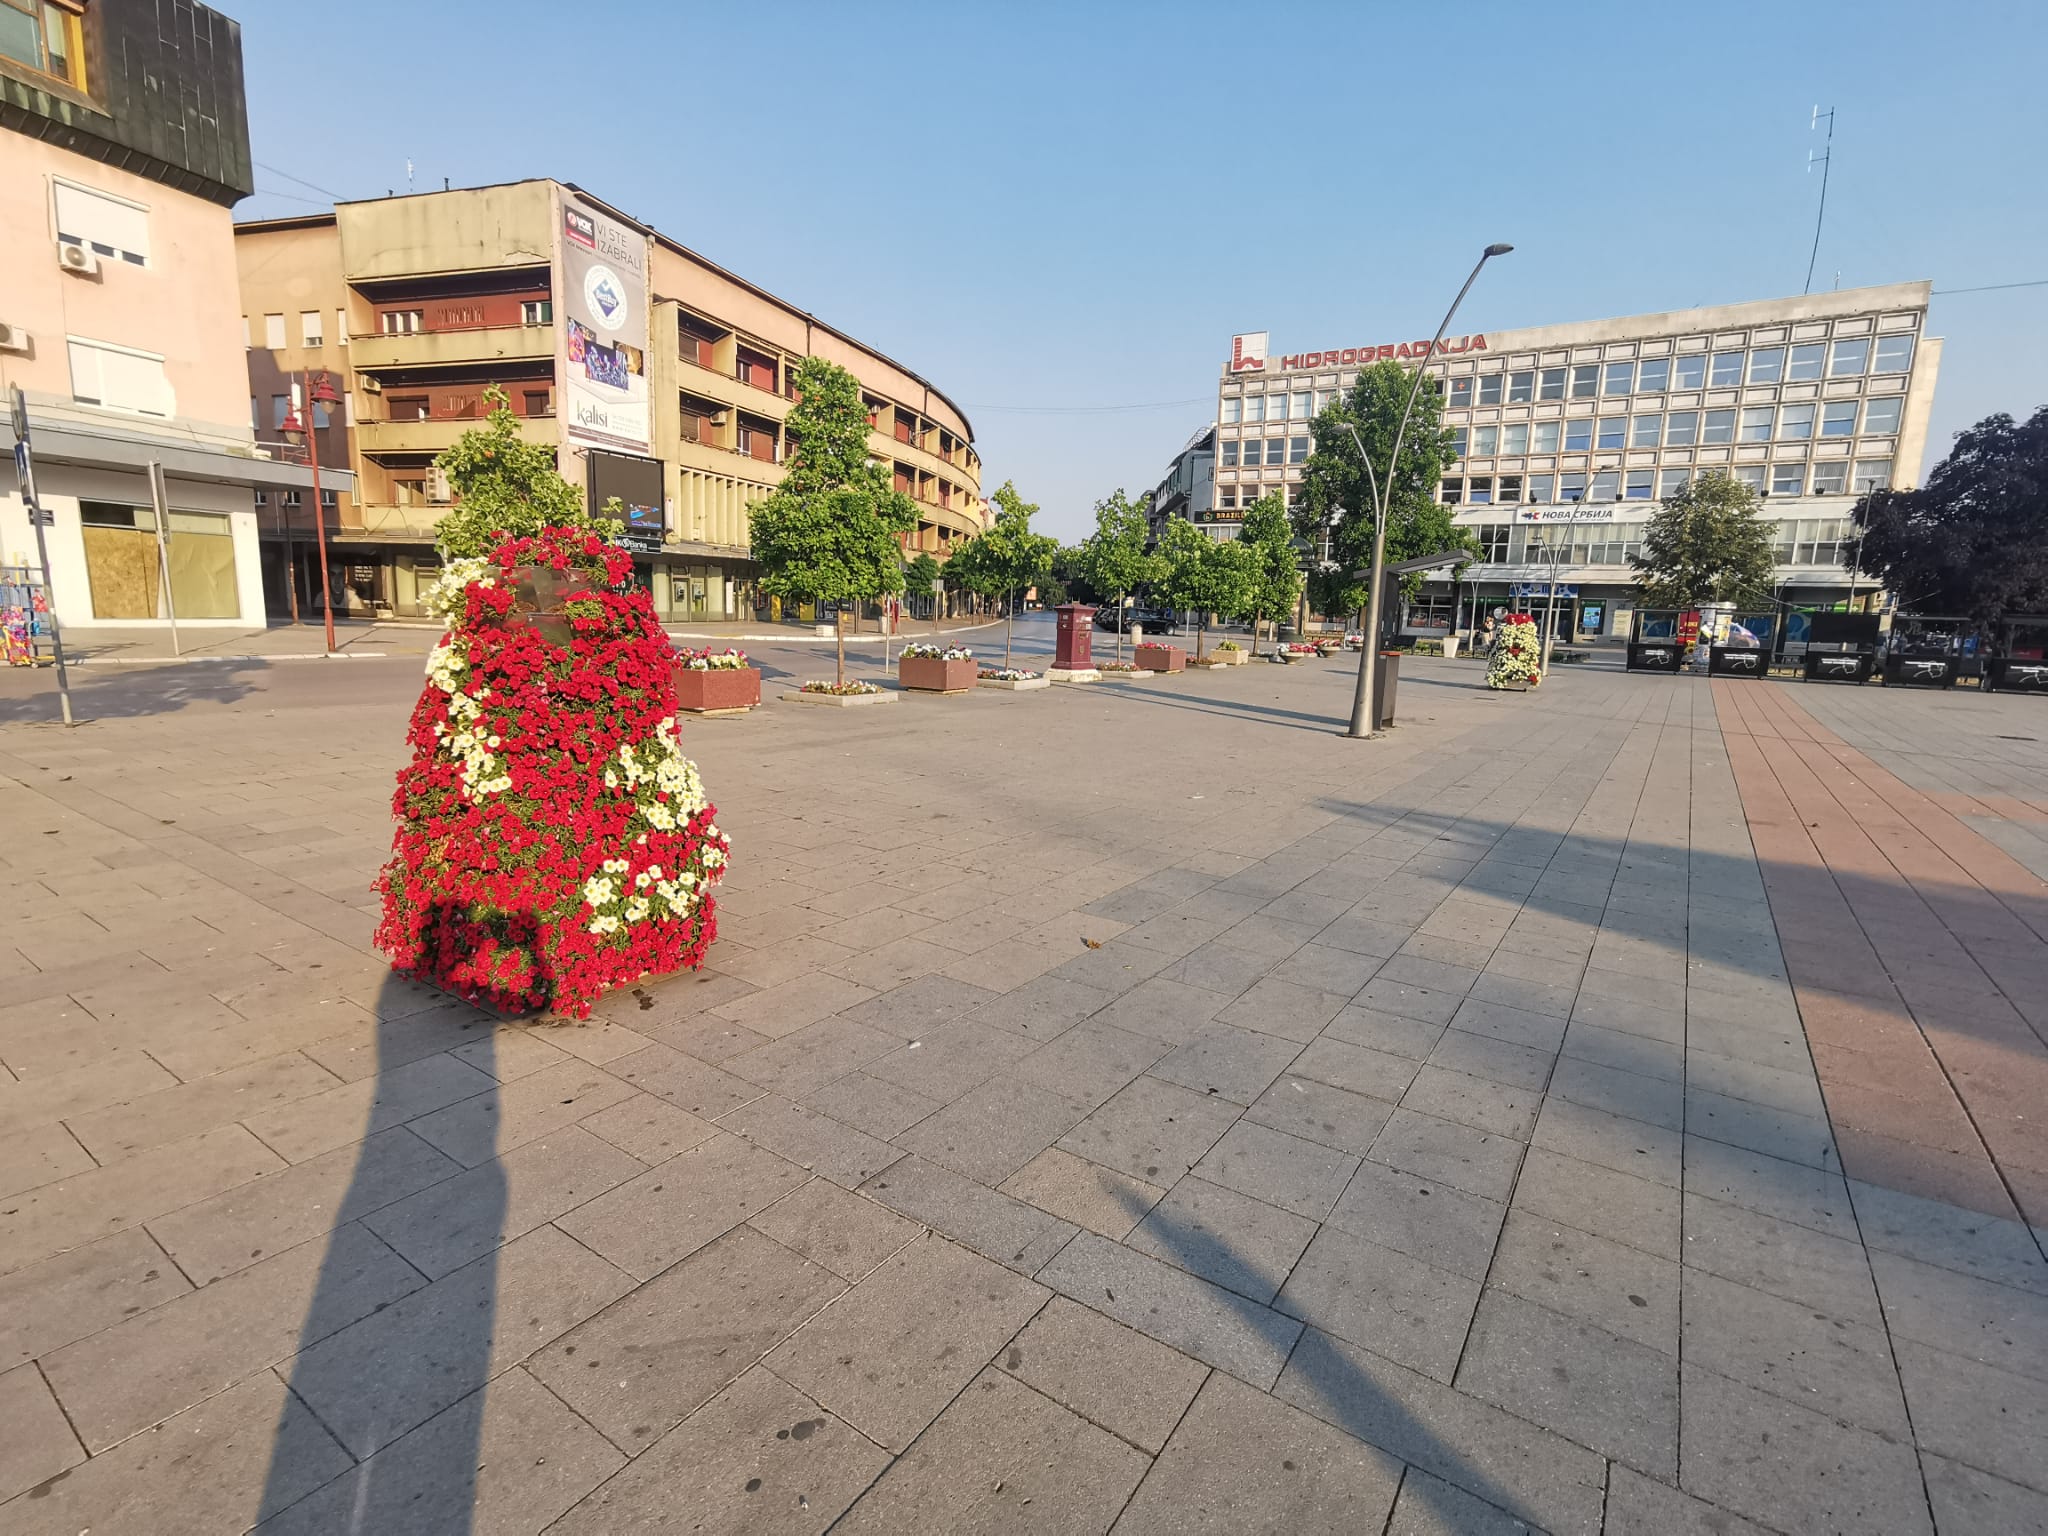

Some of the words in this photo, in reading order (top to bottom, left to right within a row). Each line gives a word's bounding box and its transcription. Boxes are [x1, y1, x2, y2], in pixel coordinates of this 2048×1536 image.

[596, 223, 606, 235] VI
[608, 228, 627, 247] STE
[597, 239, 642, 271] IZABRALI
[1282, 333, 1488, 370] HIDROGRADNJA
[1542, 511, 1571, 519] НОВА
[1573, 510, 1613, 519] СРБИЈА
